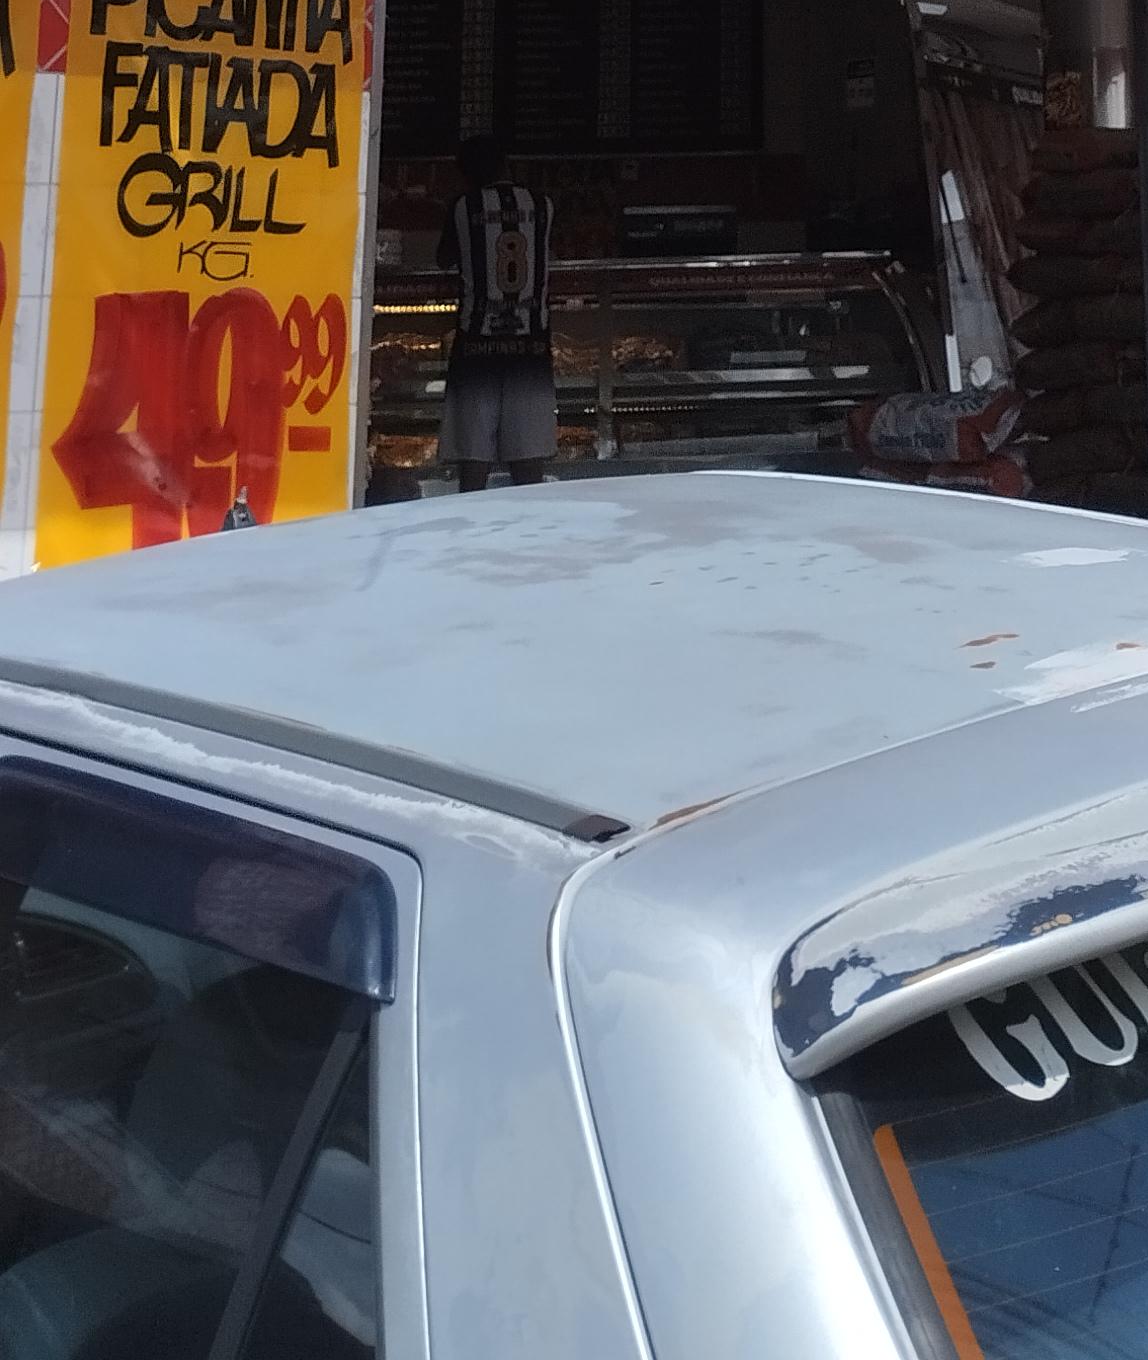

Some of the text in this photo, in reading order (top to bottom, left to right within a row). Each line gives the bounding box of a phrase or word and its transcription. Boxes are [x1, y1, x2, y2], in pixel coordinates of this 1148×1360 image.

[98, 41, 341, 168] FATIADA
[117, 153, 306, 239] GRILL
[495, 229, 528, 294] 8
